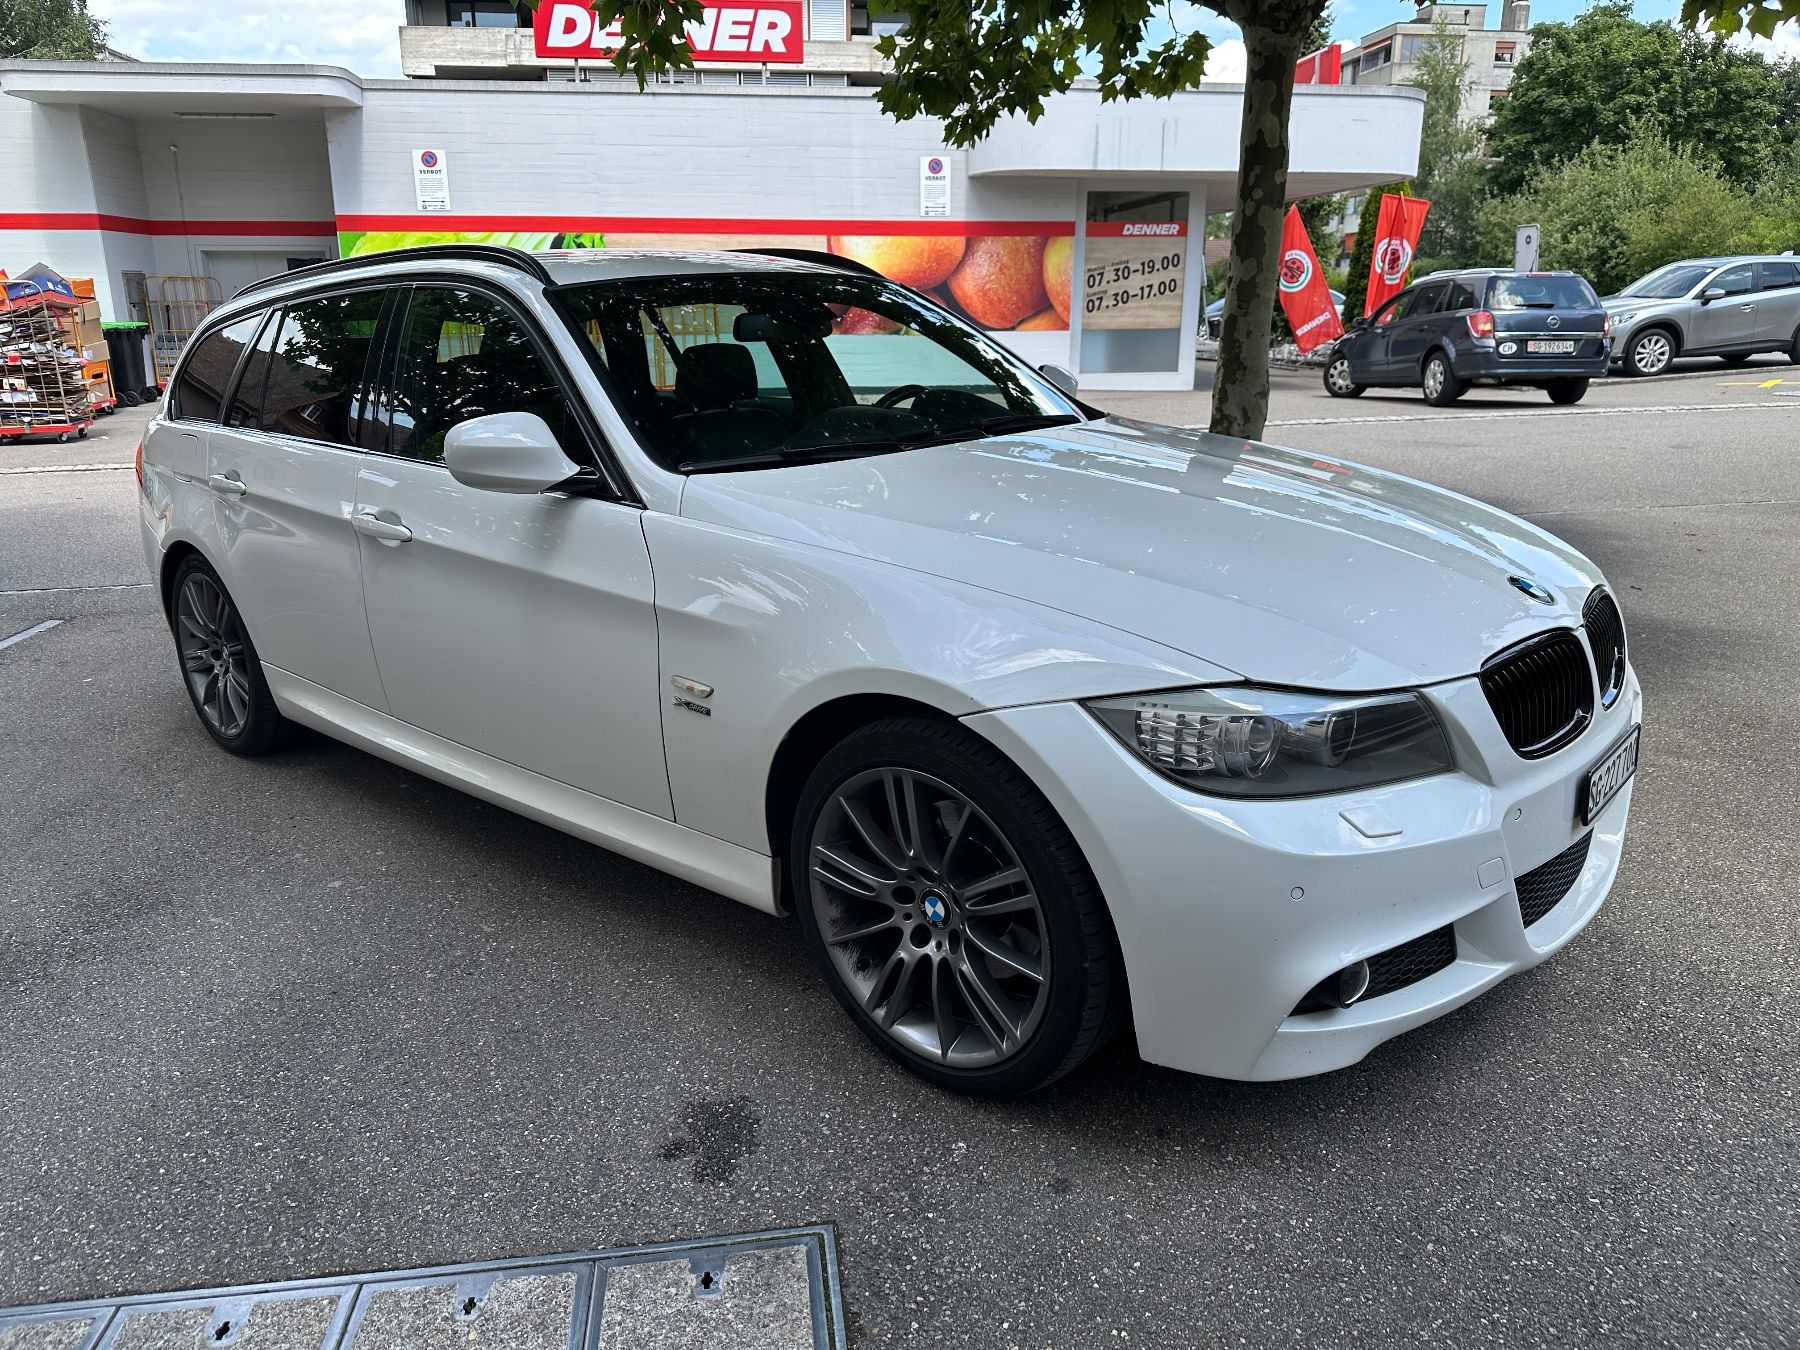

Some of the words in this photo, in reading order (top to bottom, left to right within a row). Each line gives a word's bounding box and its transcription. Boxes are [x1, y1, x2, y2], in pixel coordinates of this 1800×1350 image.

[546, 4, 792, 53] DENER
[1122, 223, 1180, 236] DENNER
[1087, 264, 1106, 273] Montag
[1086, 289, 1108, 298] Samstag
[1502, 345, 1513, 353] CH
